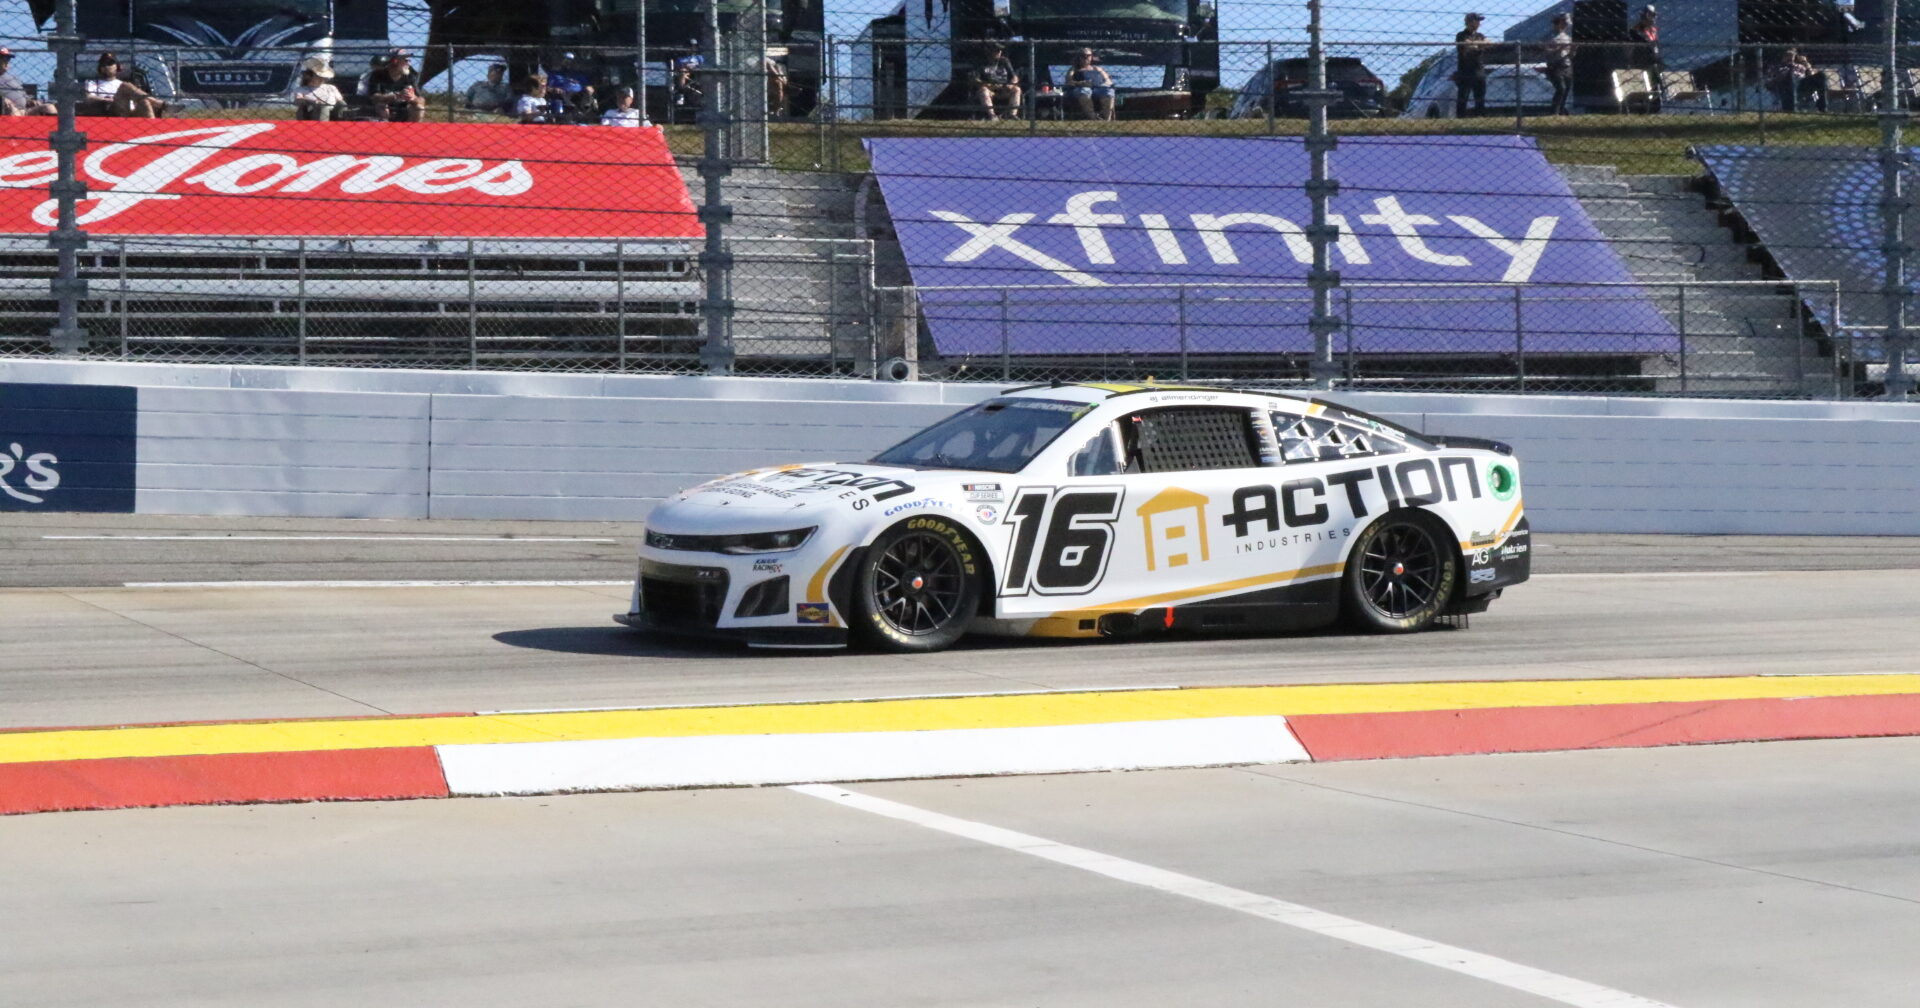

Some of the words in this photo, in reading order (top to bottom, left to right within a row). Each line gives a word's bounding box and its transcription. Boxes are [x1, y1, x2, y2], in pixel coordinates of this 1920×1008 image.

[32, 122, 534, 227] Jones
[929, 190, 1560, 287] xfinity
[997, 484, 1126, 597] 16
[1223, 457, 1482, 537] ACTION
[1236, 527, 1351, 553] INDUSTRIES
[907, 518, 975, 575] GOODYEAR
